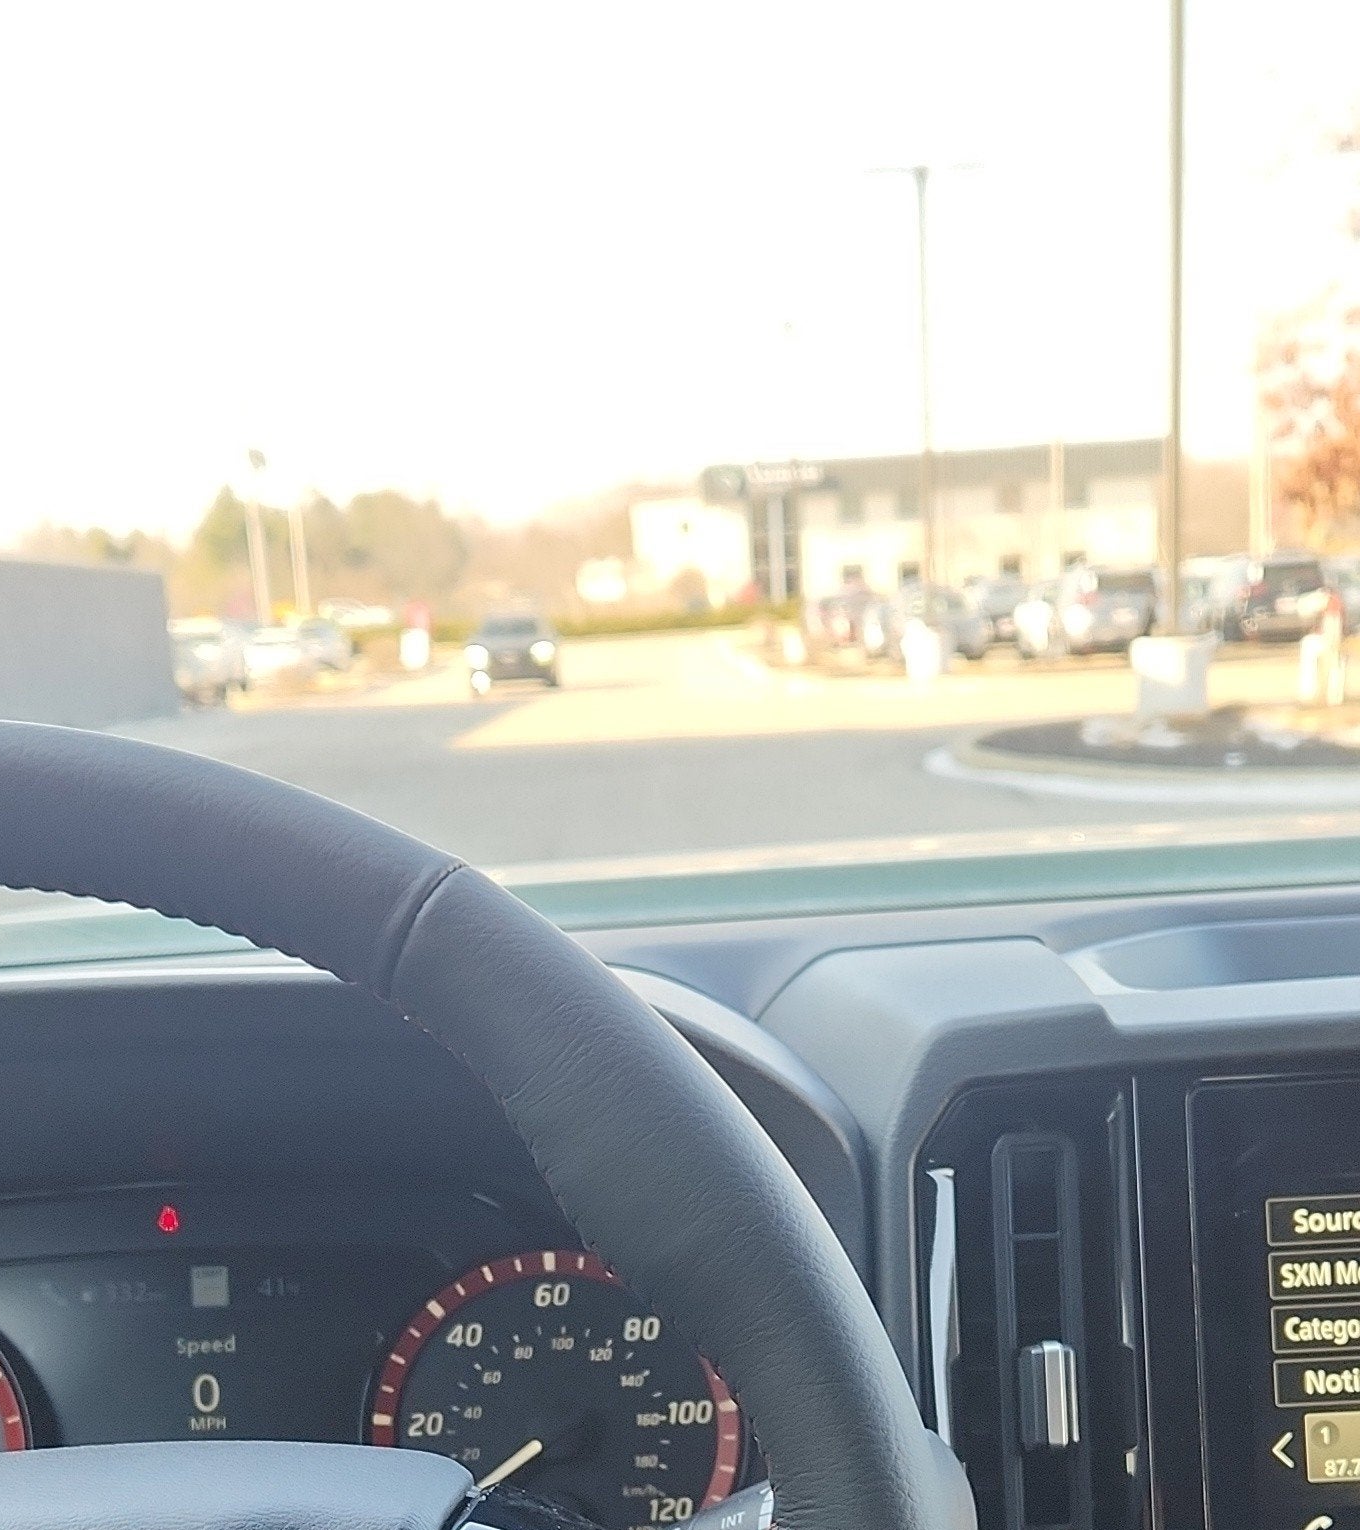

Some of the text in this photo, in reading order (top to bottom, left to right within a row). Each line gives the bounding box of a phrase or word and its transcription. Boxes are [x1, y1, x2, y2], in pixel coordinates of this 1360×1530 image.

[1280, 1261, 1332, 1288] SXM
[534, 1283, 571, 1307] 60
[446, 1323, 483, 1347] 40
[623, 1316, 661, 1342] 80
[177, 1334, 236, 1357] Speed
[551, 1337, 574, 1351] 100
[590, 1348, 612, 1362] 120
[482, 1370, 502, 1384] 60
[192, 1373, 220, 1413] 0
[191, 1417, 227, 1431] MPH
[408, 1411, 444, 1437] 20
[463, 1406, 483, 1420] 40
[668, 1400, 713, 1425] 100
[1320, 1426, 1331, 1445] 1
[462, 1448, 481, 1461] 20
[650, 1497, 694, 1521] 120
[721, 1511, 746, 1529] INT
